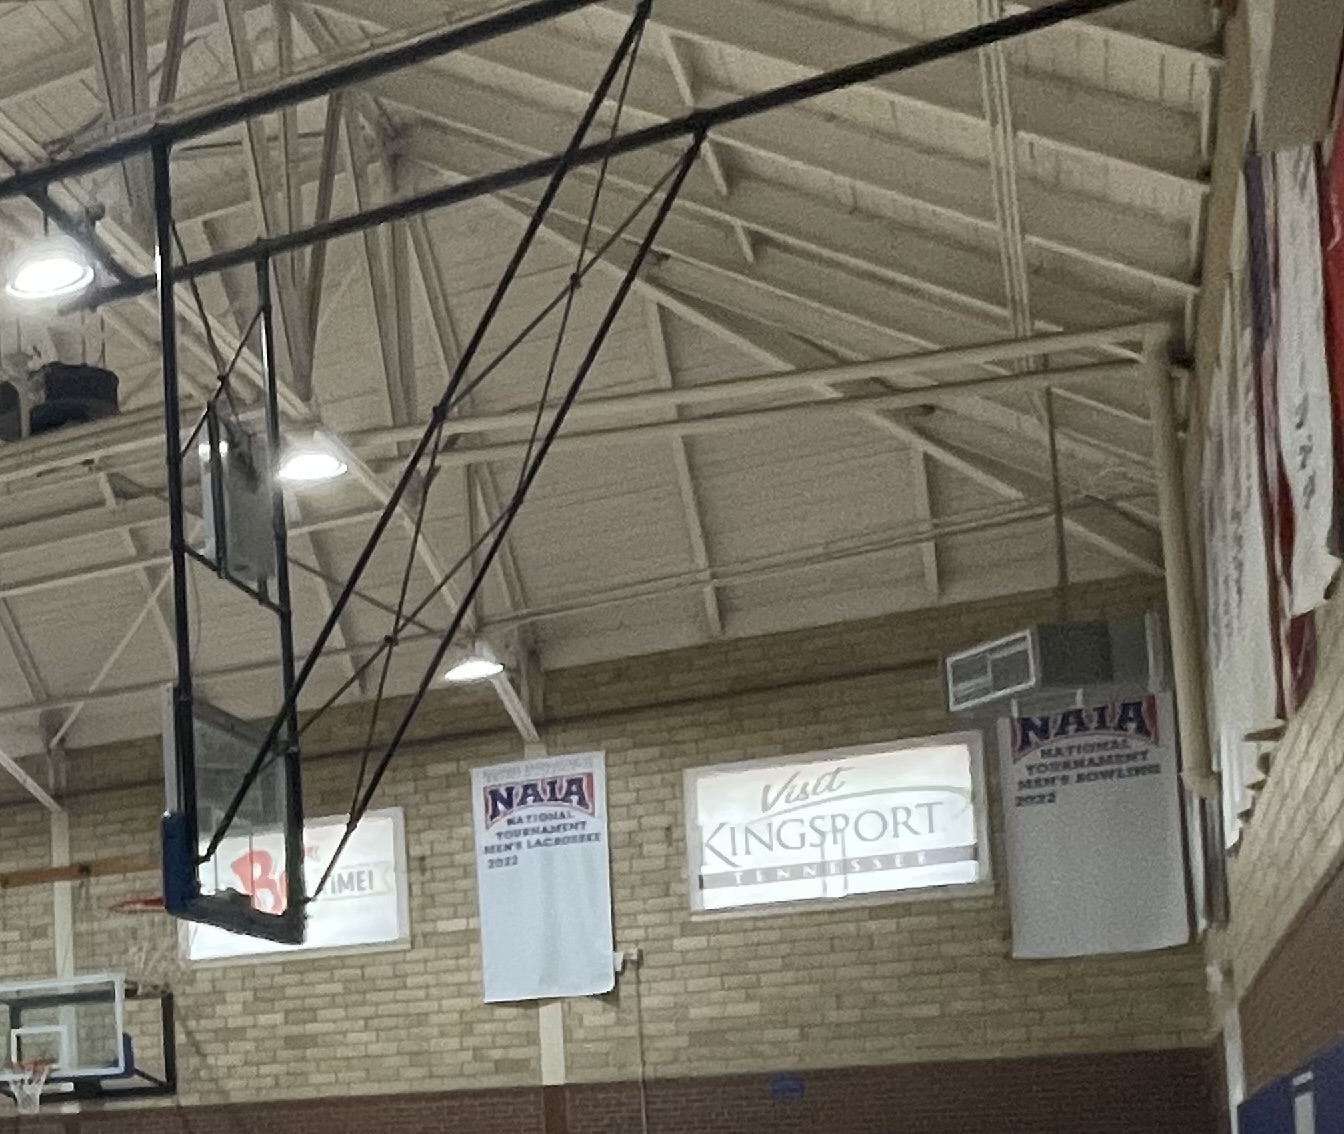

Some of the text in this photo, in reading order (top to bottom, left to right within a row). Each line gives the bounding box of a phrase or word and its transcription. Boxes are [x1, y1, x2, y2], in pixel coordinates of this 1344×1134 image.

[1017, 702, 1151, 752] NAIA
[1025, 749, 1149, 775] TOURNAMENT
[1040, 739, 1131, 760] NATIONAL
[488, 777, 590, 822] NAIA
[760, 766, 855, 814] Visit
[496, 821, 588, 840] TOURNAMENT
[507, 811, 576, 826] NATIONAL
[484, 840, 523, 855] MEN'S
[704, 801, 945, 868] KINGSPORT
[487, 854, 519, 869] 2022
[733, 850, 927, 886] TENNESSEE
